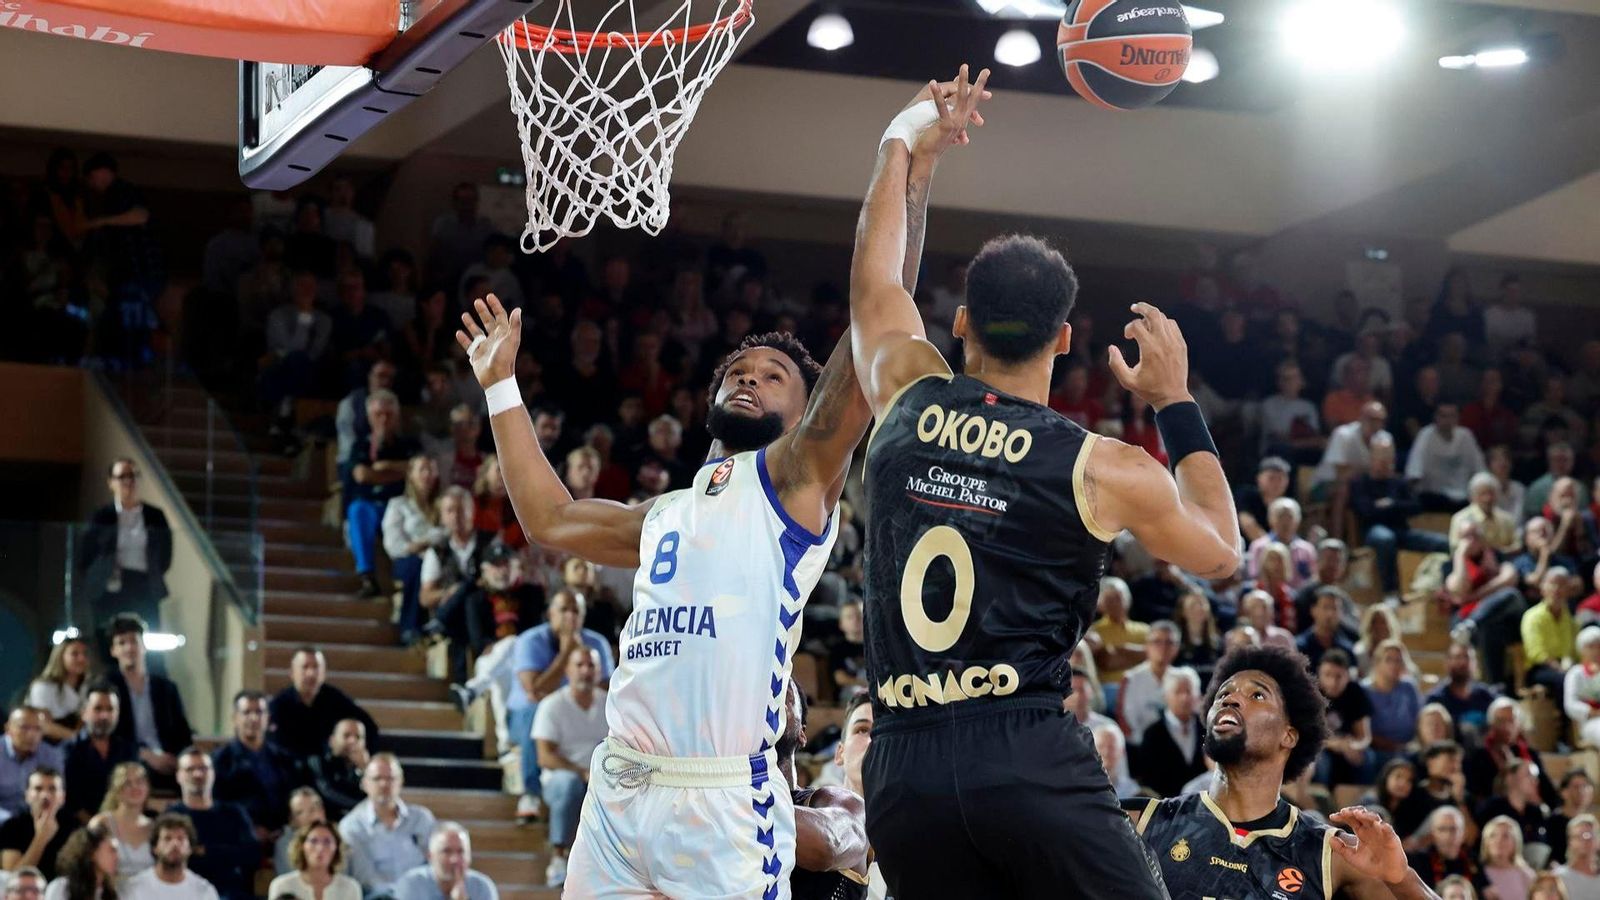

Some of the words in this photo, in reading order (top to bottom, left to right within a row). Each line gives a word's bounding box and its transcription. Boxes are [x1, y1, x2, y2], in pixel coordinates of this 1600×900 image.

[917, 404, 1033, 463] OKOBO
[650, 531, 680, 584] 8
[901, 525, 975, 653] 0
[627, 641, 681, 660] BASKET
[877, 664, 1020, 709] MONACO
[1210, 856, 1248, 873] SPALDING
